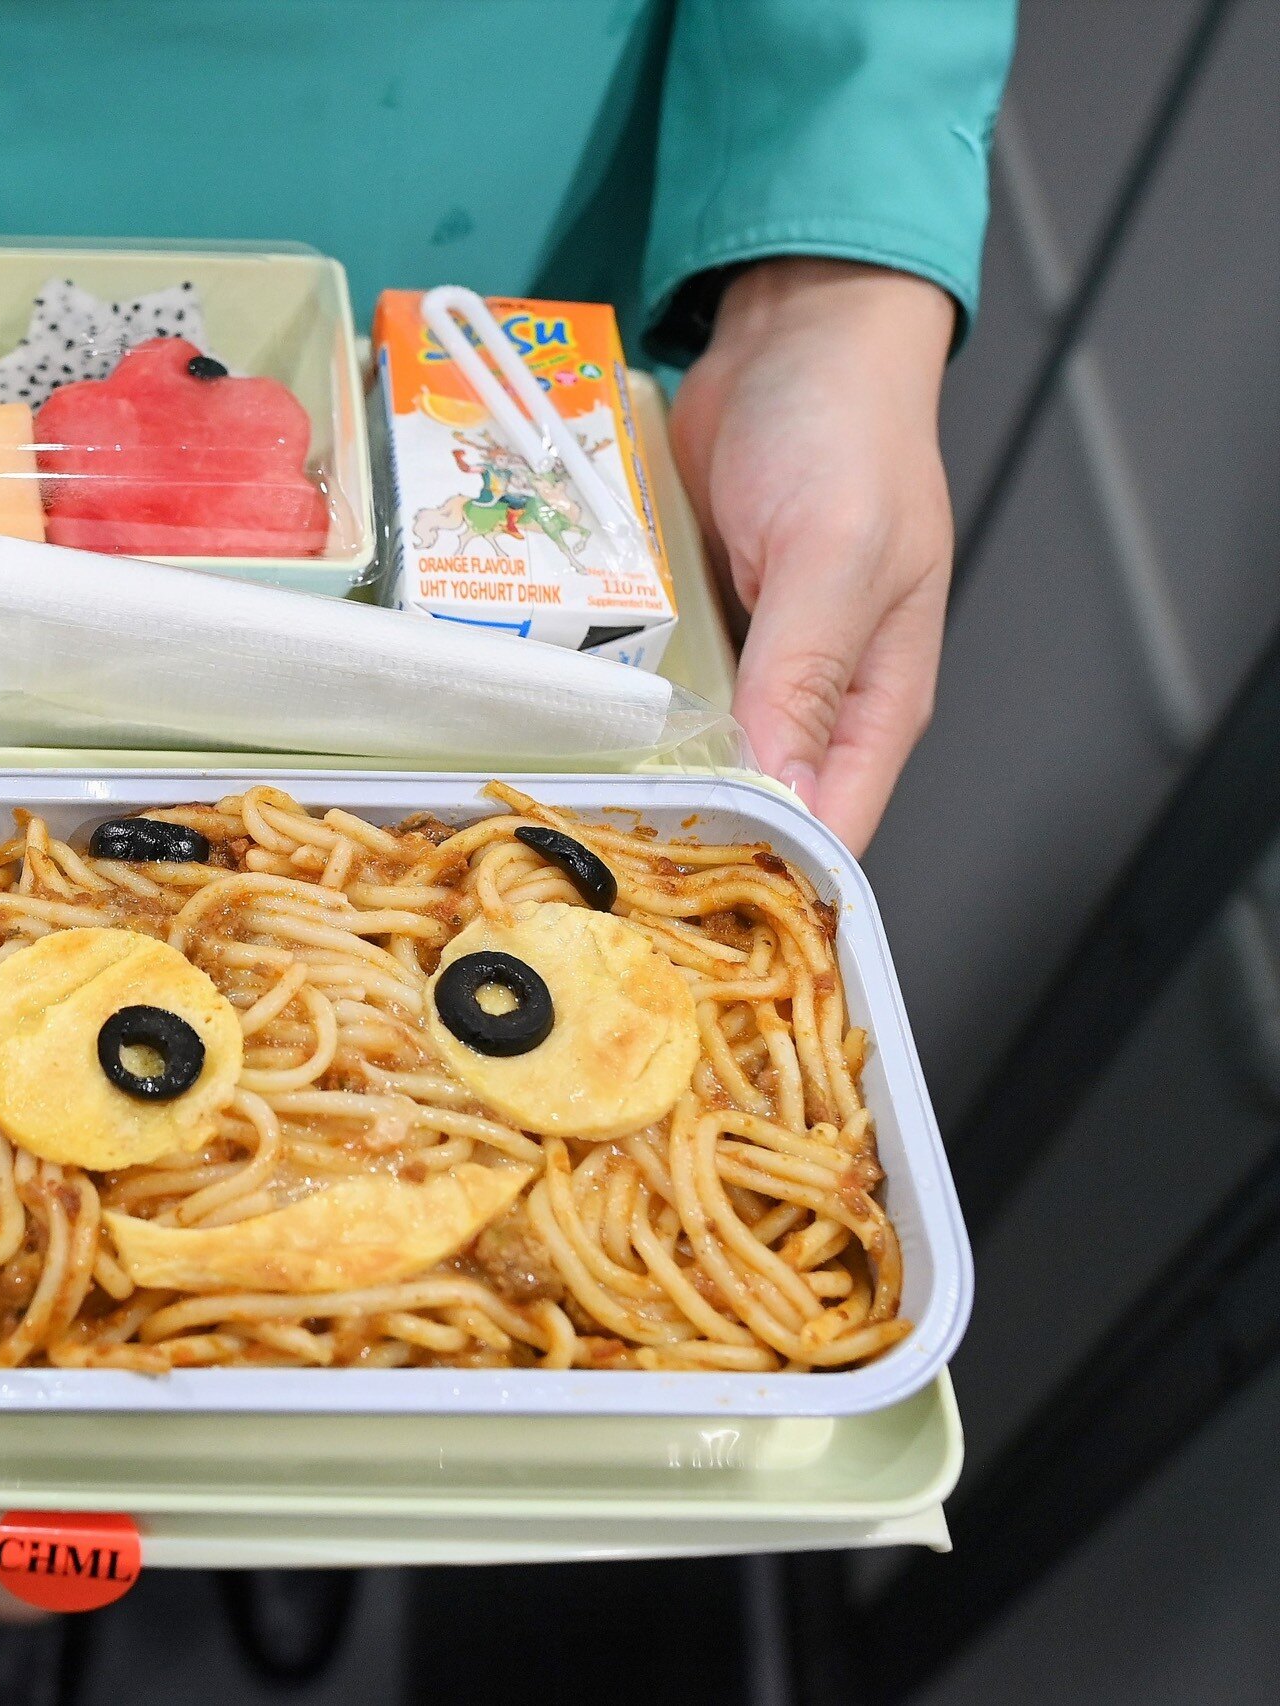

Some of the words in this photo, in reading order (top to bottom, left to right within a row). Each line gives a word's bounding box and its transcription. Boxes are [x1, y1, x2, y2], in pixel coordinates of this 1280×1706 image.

[419, 557, 469, 573] ORANGE
[471, 558, 526, 576] FLAVOUR
[420, 580, 447, 597] UHT
[451, 581, 514, 600] YOGHURT
[518, 584, 561, 603] DRINK
[603, 580, 632, 595] 110
